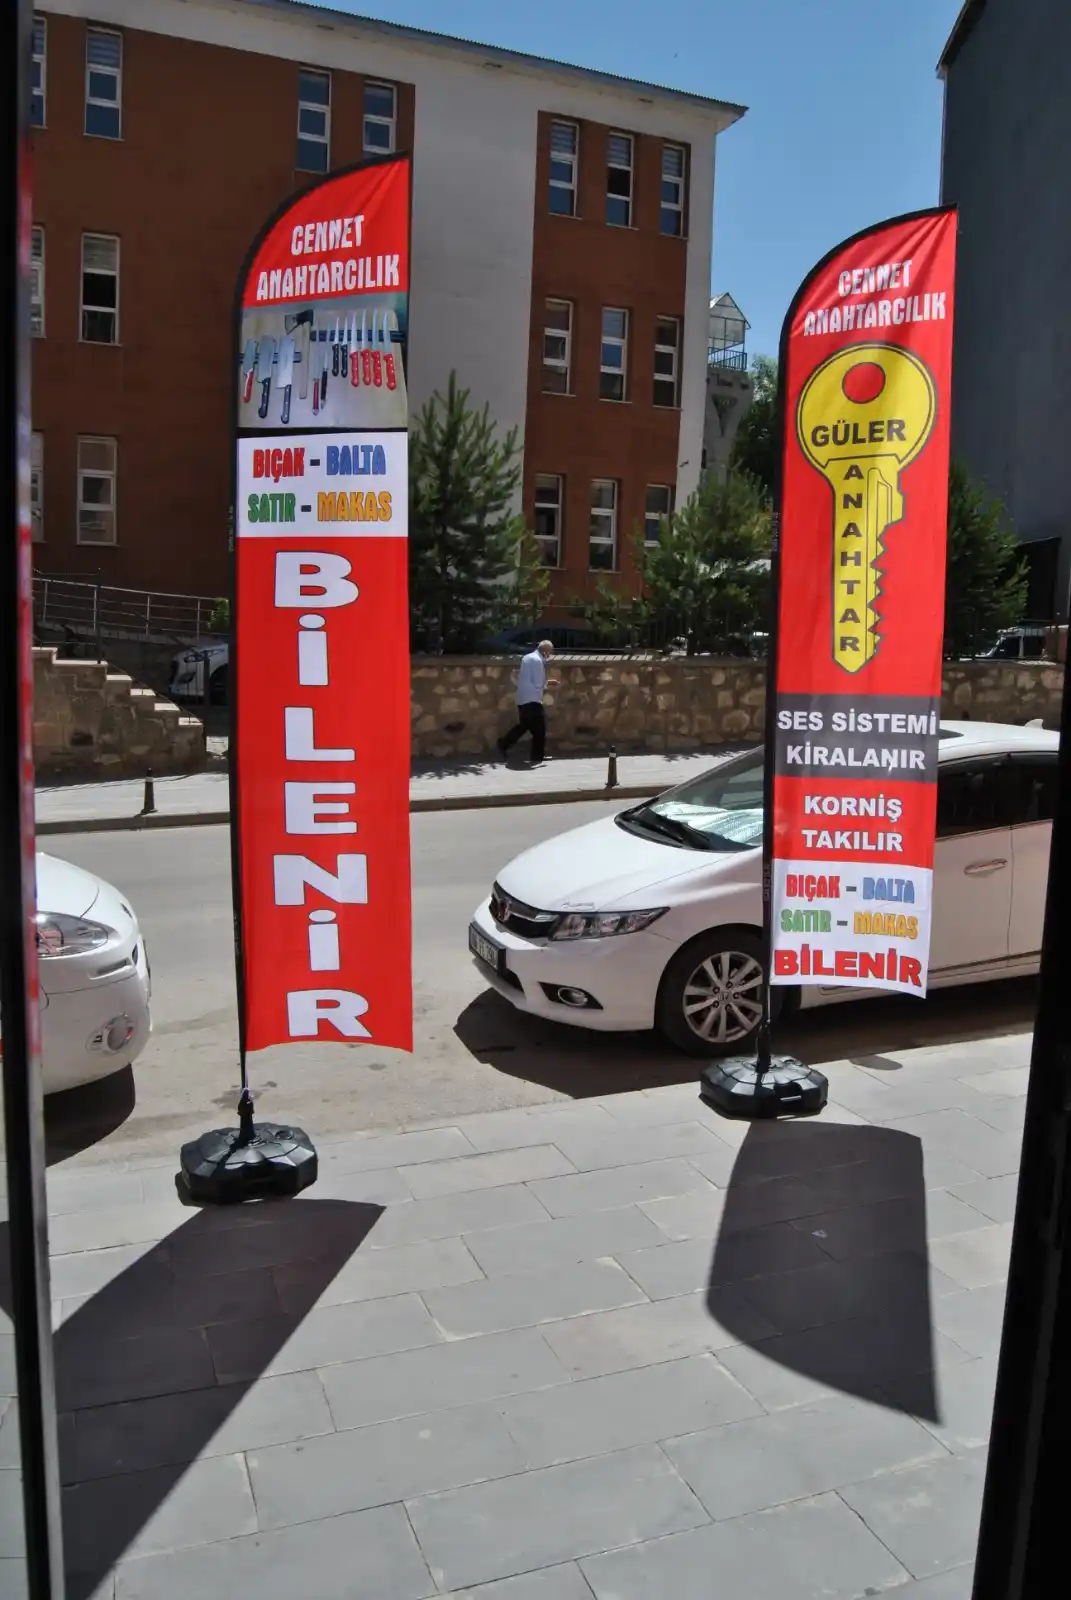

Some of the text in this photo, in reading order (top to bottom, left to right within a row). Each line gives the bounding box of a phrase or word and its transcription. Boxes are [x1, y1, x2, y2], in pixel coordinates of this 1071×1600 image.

[291, 214, 365, 257] CENNET
[256, 255, 400, 301] ANAHTARCILIK
[838, 259, 912, 297] CENNET
[803, 292, 946, 336] ANAHTARCILIK
[811, 419, 907, 448] GÜLER
[252, 446, 306, 483] BIÇAK
[326, 444, 387, 476] BALTA
[247, 493, 296, 523] SATIR
[317, 490, 393, 522] MAKAS
[839, 463, 865, 652] ANAHTAR
[777, 708, 937, 736] SES SİSTEMİ
[786, 741, 926, 770] KİRALANIR
[803, 793, 904, 823] KORNİŞ
[801, 829, 904, 852] TAKILIR
[785, 874, 841, 902] BIÇAK
[862, 877, 915, 904] BALTA
[780, 909, 832, 933] SATIR
[853, 911, 919, 940] MAKAS
[773, 943, 923, 987] BİLENİR
